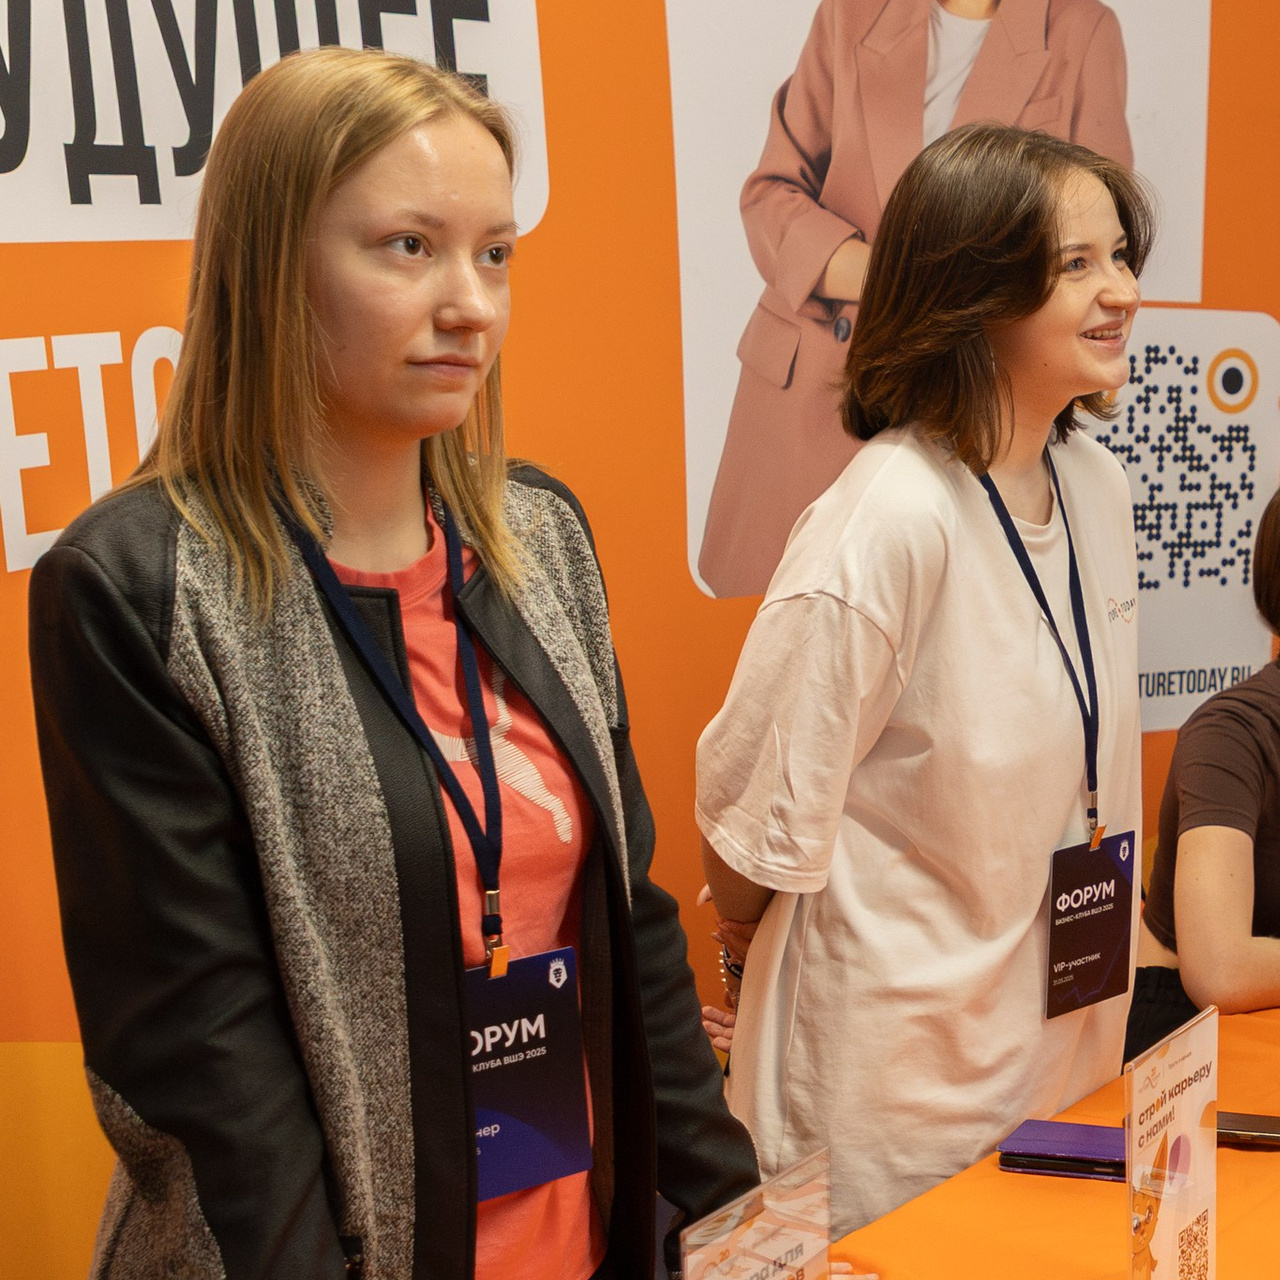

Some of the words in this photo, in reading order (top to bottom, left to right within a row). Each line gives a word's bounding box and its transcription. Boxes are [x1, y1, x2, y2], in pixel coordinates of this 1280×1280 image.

[1056, 879, 1115, 913] ФОРУМ
[1053, 952, 1101, 973] VIP-участник
[472, 1058, 502, 1073] КЛУБА
[503, 1052, 525, 1065] ВШЭ
[526, 1046, 547, 1060] 2025
[1168, 1061, 1212, 1101] карьеру
[1138, 1135, 1144, 1149] с
[1146, 1105, 1175, 1142] нами!
[772, 1243, 805, 1277] для
